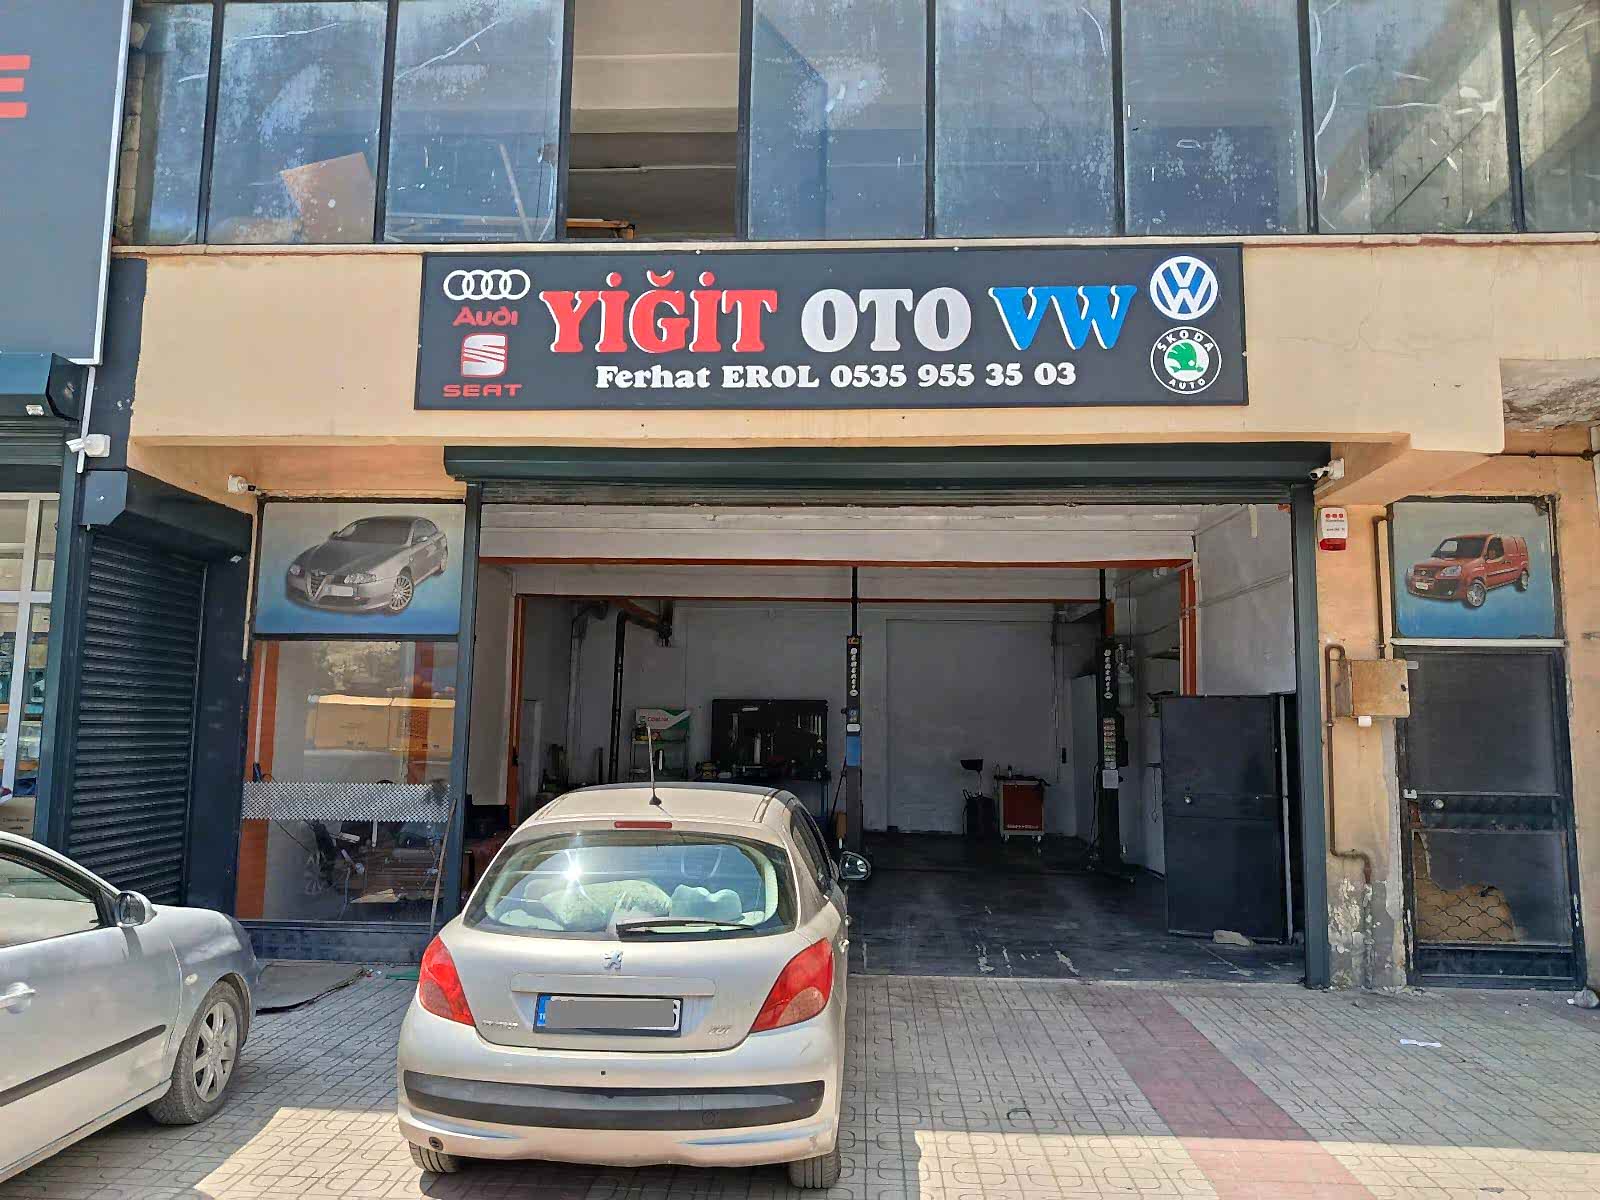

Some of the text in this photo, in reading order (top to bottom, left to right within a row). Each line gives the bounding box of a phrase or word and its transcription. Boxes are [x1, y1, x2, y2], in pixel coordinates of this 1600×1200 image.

[539, 270, 1138, 354] YİĞİT OTO VW
[1157, 329, 1214, 352] SKODA
[595, 361, 1077, 389] Ferhat EROL 0535 955 35 03
[1168, 377, 1206, 390] AUTO
[443, 383, 523, 398] SEAT
